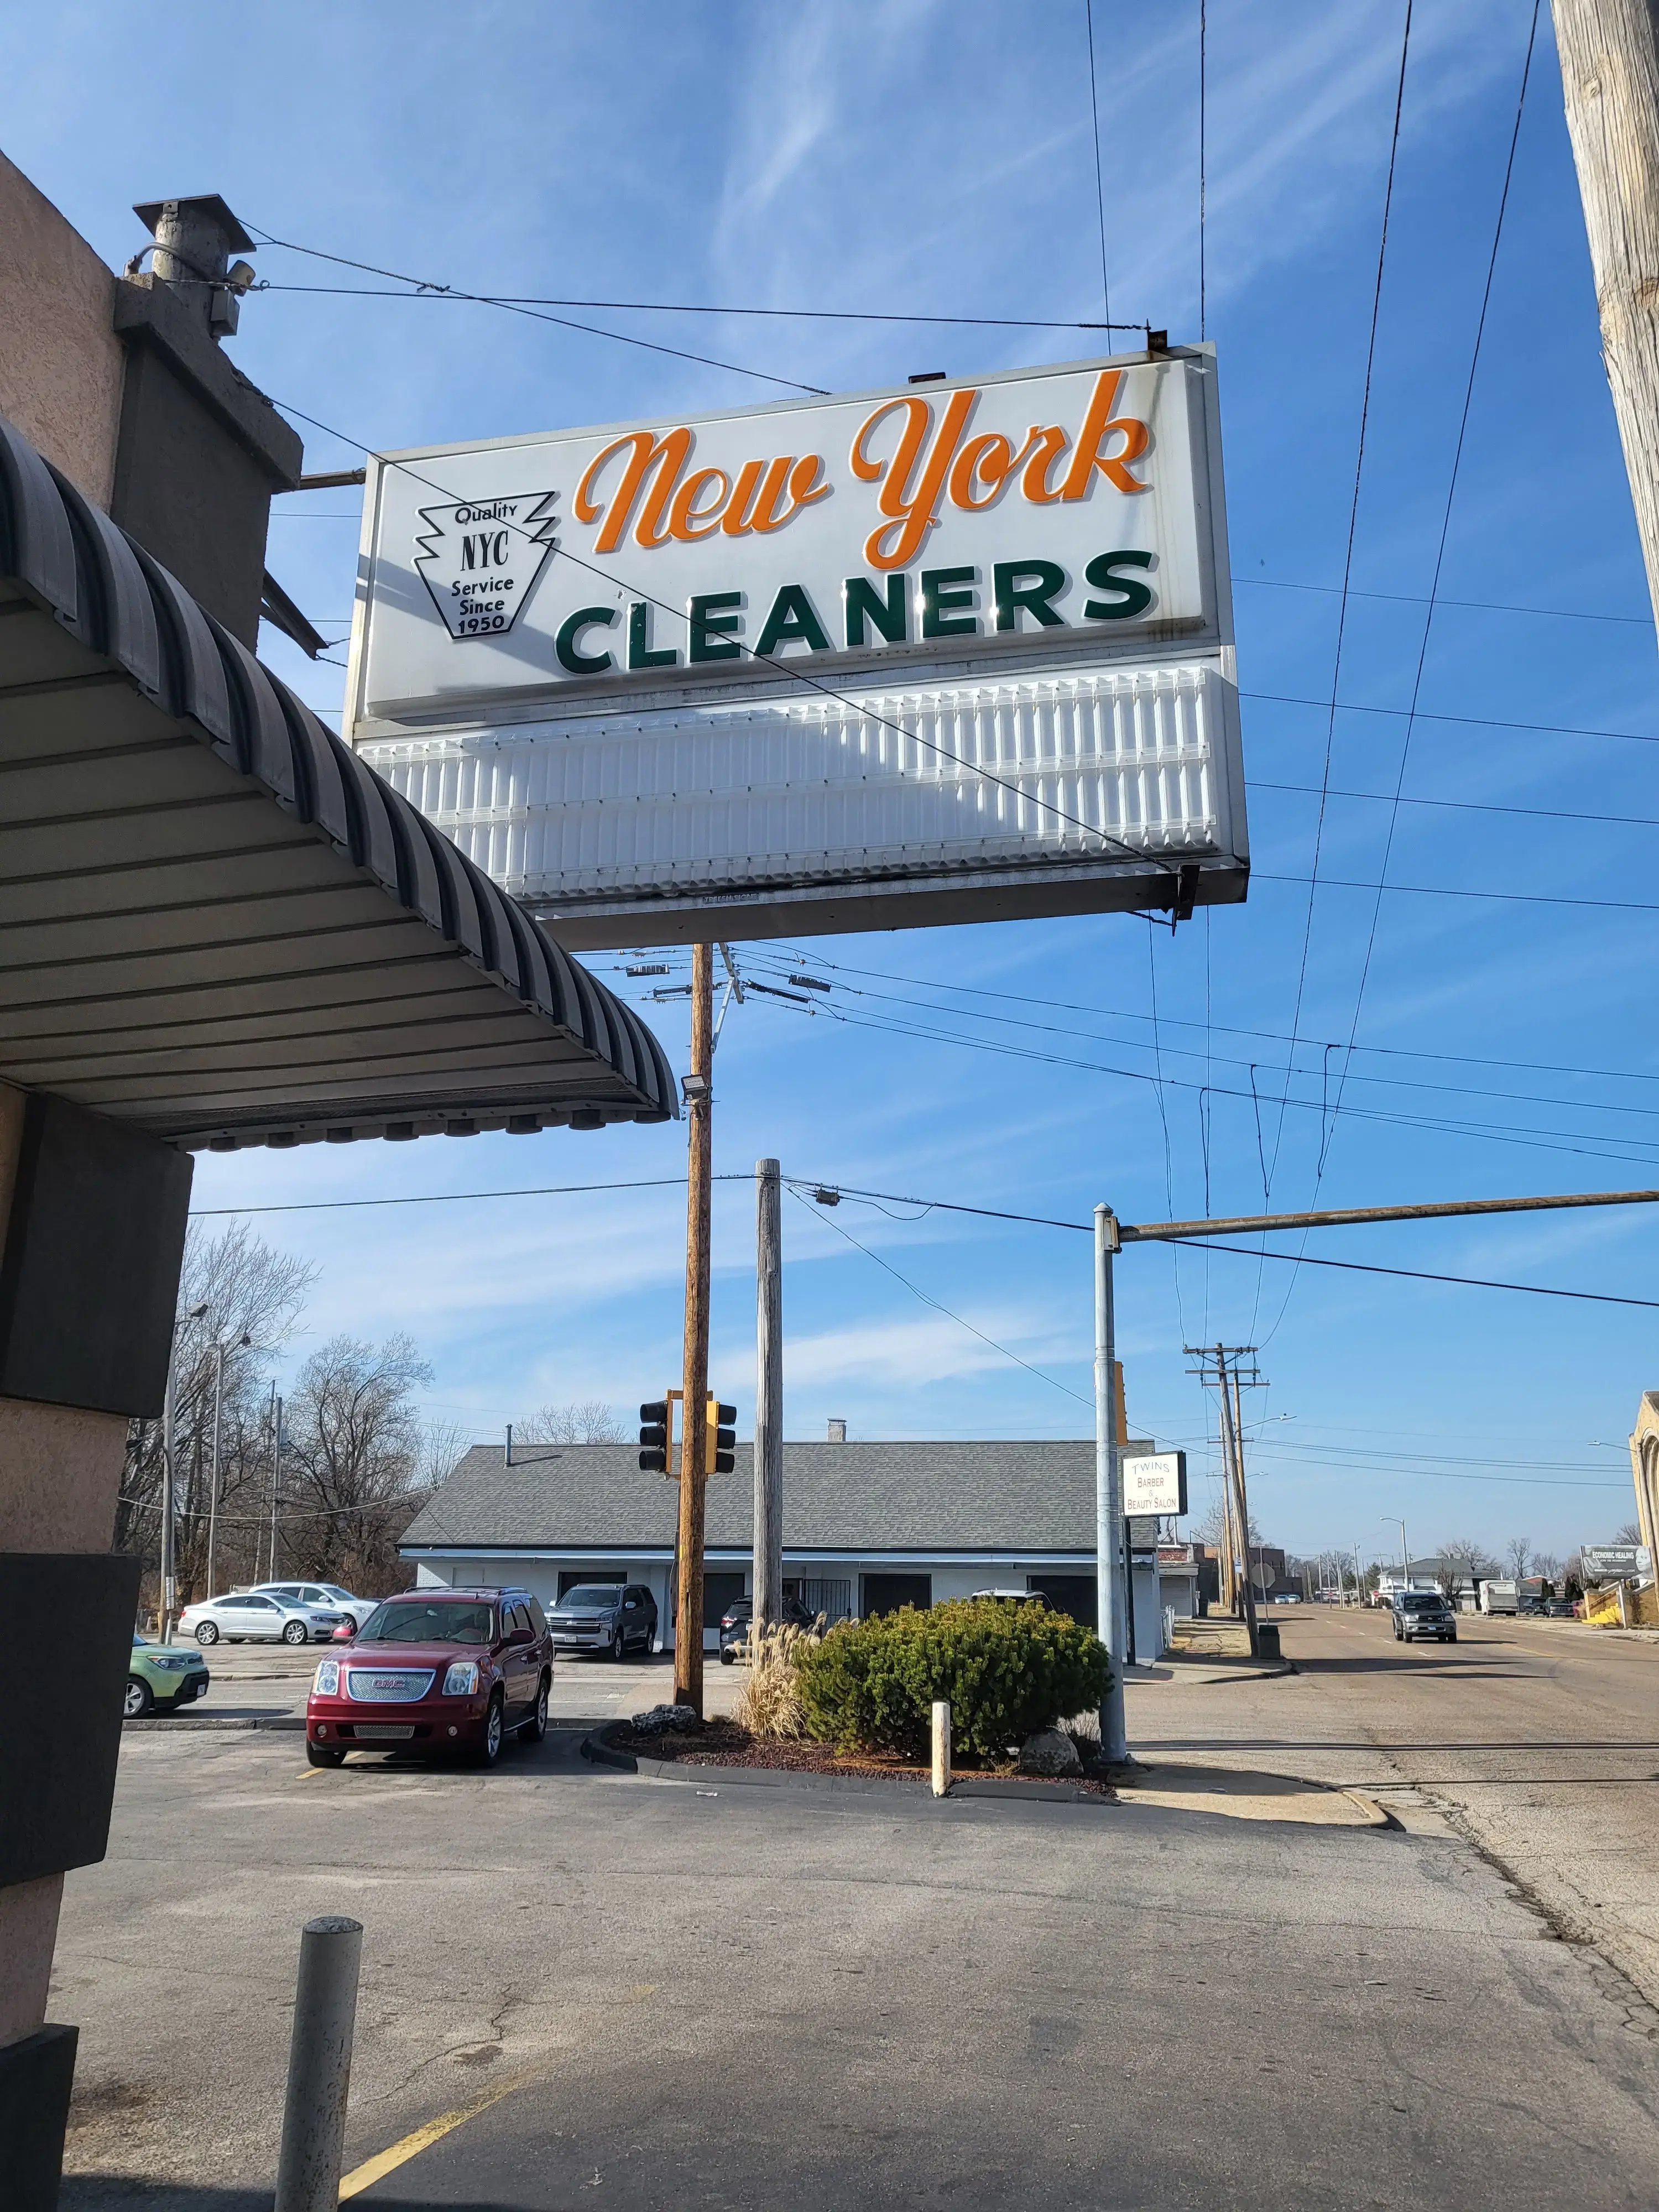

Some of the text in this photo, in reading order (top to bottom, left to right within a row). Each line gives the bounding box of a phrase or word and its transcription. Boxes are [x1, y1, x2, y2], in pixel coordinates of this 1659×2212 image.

[573, 369, 1149, 570] New York
[455, 502, 518, 525] Quality
[460, 530, 509, 571] NYC
[451, 577, 514, 597] Service
[460, 599, 505, 615] Since
[555, 550, 1154, 675] CLEANERS
[458, 615, 504, 634] 1950
[1131, 1462, 1170, 1474] TWINS
[1138, 1477, 1164, 1488] BARBER
[1128, 1498, 1176, 1510] BEAUTY SALON
[372, 1679, 404, 1688] GMC
